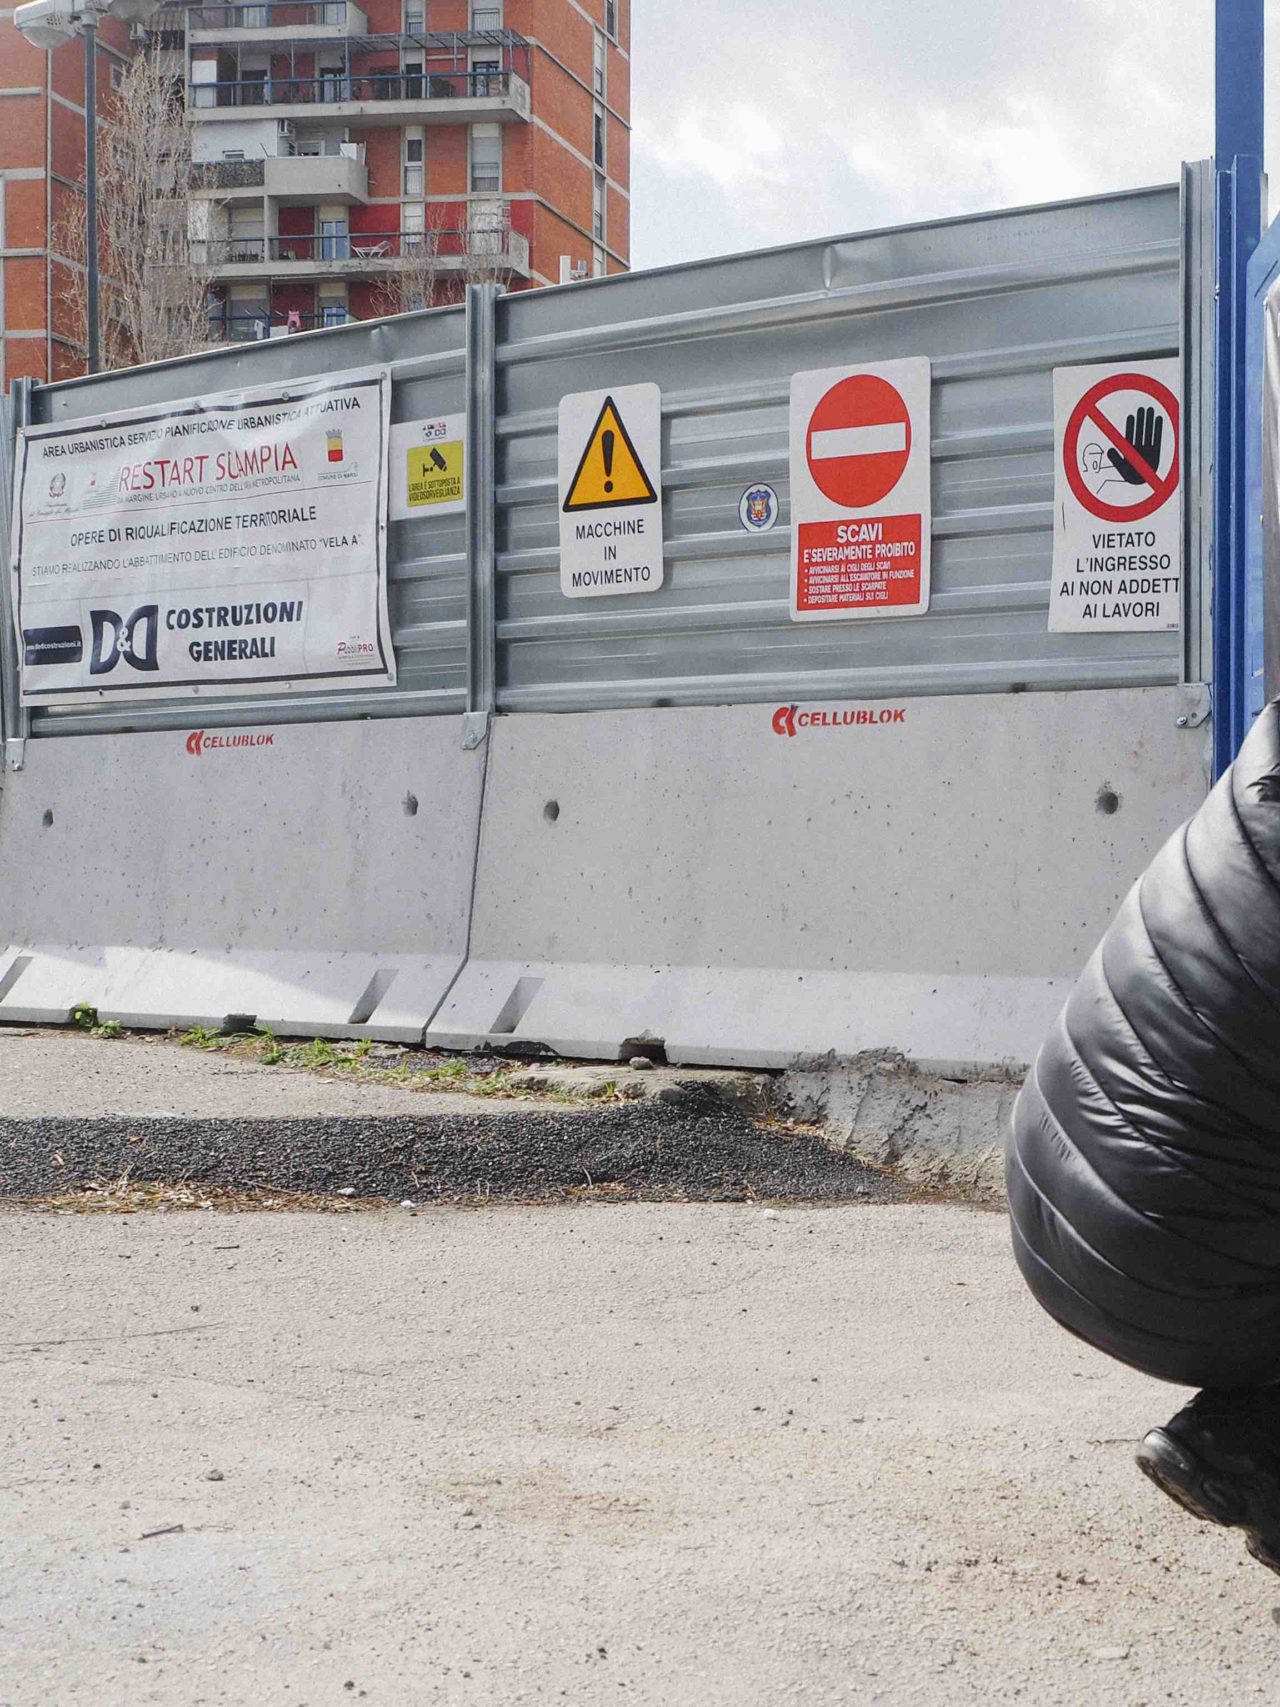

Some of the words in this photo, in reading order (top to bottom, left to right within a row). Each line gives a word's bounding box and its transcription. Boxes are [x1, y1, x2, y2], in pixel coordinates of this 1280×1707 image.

[42, 446, 67, 459] AREA
[67, 436, 126, 455] URBANISTICA
[237, 409, 301, 430] URBANISTICA
[303, 396, 361, 417] ATTUATIVA
[119, 455, 209, 492] RESTART
[71, 529, 105, 547] OPERE
[109, 527, 121, 542] DI
[126, 515, 232, 541] RIQUALIFICAZIONE
[235, 505, 317, 529] TERRITORIALE
[575, 519, 645, 540] MACCHINE
[836, 523, 883, 543] SCAVI
[875, 541, 915, 558] PROIBITO
[1092, 531, 1156, 549] VIETATO
[32, 564, 60, 576] STIAMO
[62, 559, 120, 574] REALIZZANDO
[122, 551, 192, 569] L'ABBATTIMENTO
[219, 545, 257, 559] EDIFCIO
[259, 539, 317, 556] DENOMINATO
[604, 546, 617, 560] IN
[1076, 554, 1171, 573] L'INGRESSO
[572, 566, 650, 587] MOVIMENTO
[889, 569, 914, 579] FUNZIONE
[853, 582, 860, 591] LE
[1059, 581, 1075, 597] AI
[1079, 580, 1112, 596] NON
[165, 600, 304, 630] COSTRUZIONI
[1082, 604, 1097, 618] AI
[1102, 602, 1160, 618] LAVORI
[188, 636, 276, 663] GENERALI
[798, 709, 906, 727] CELLUBLOK
[203, 733, 274, 748] CELLUBLOK
